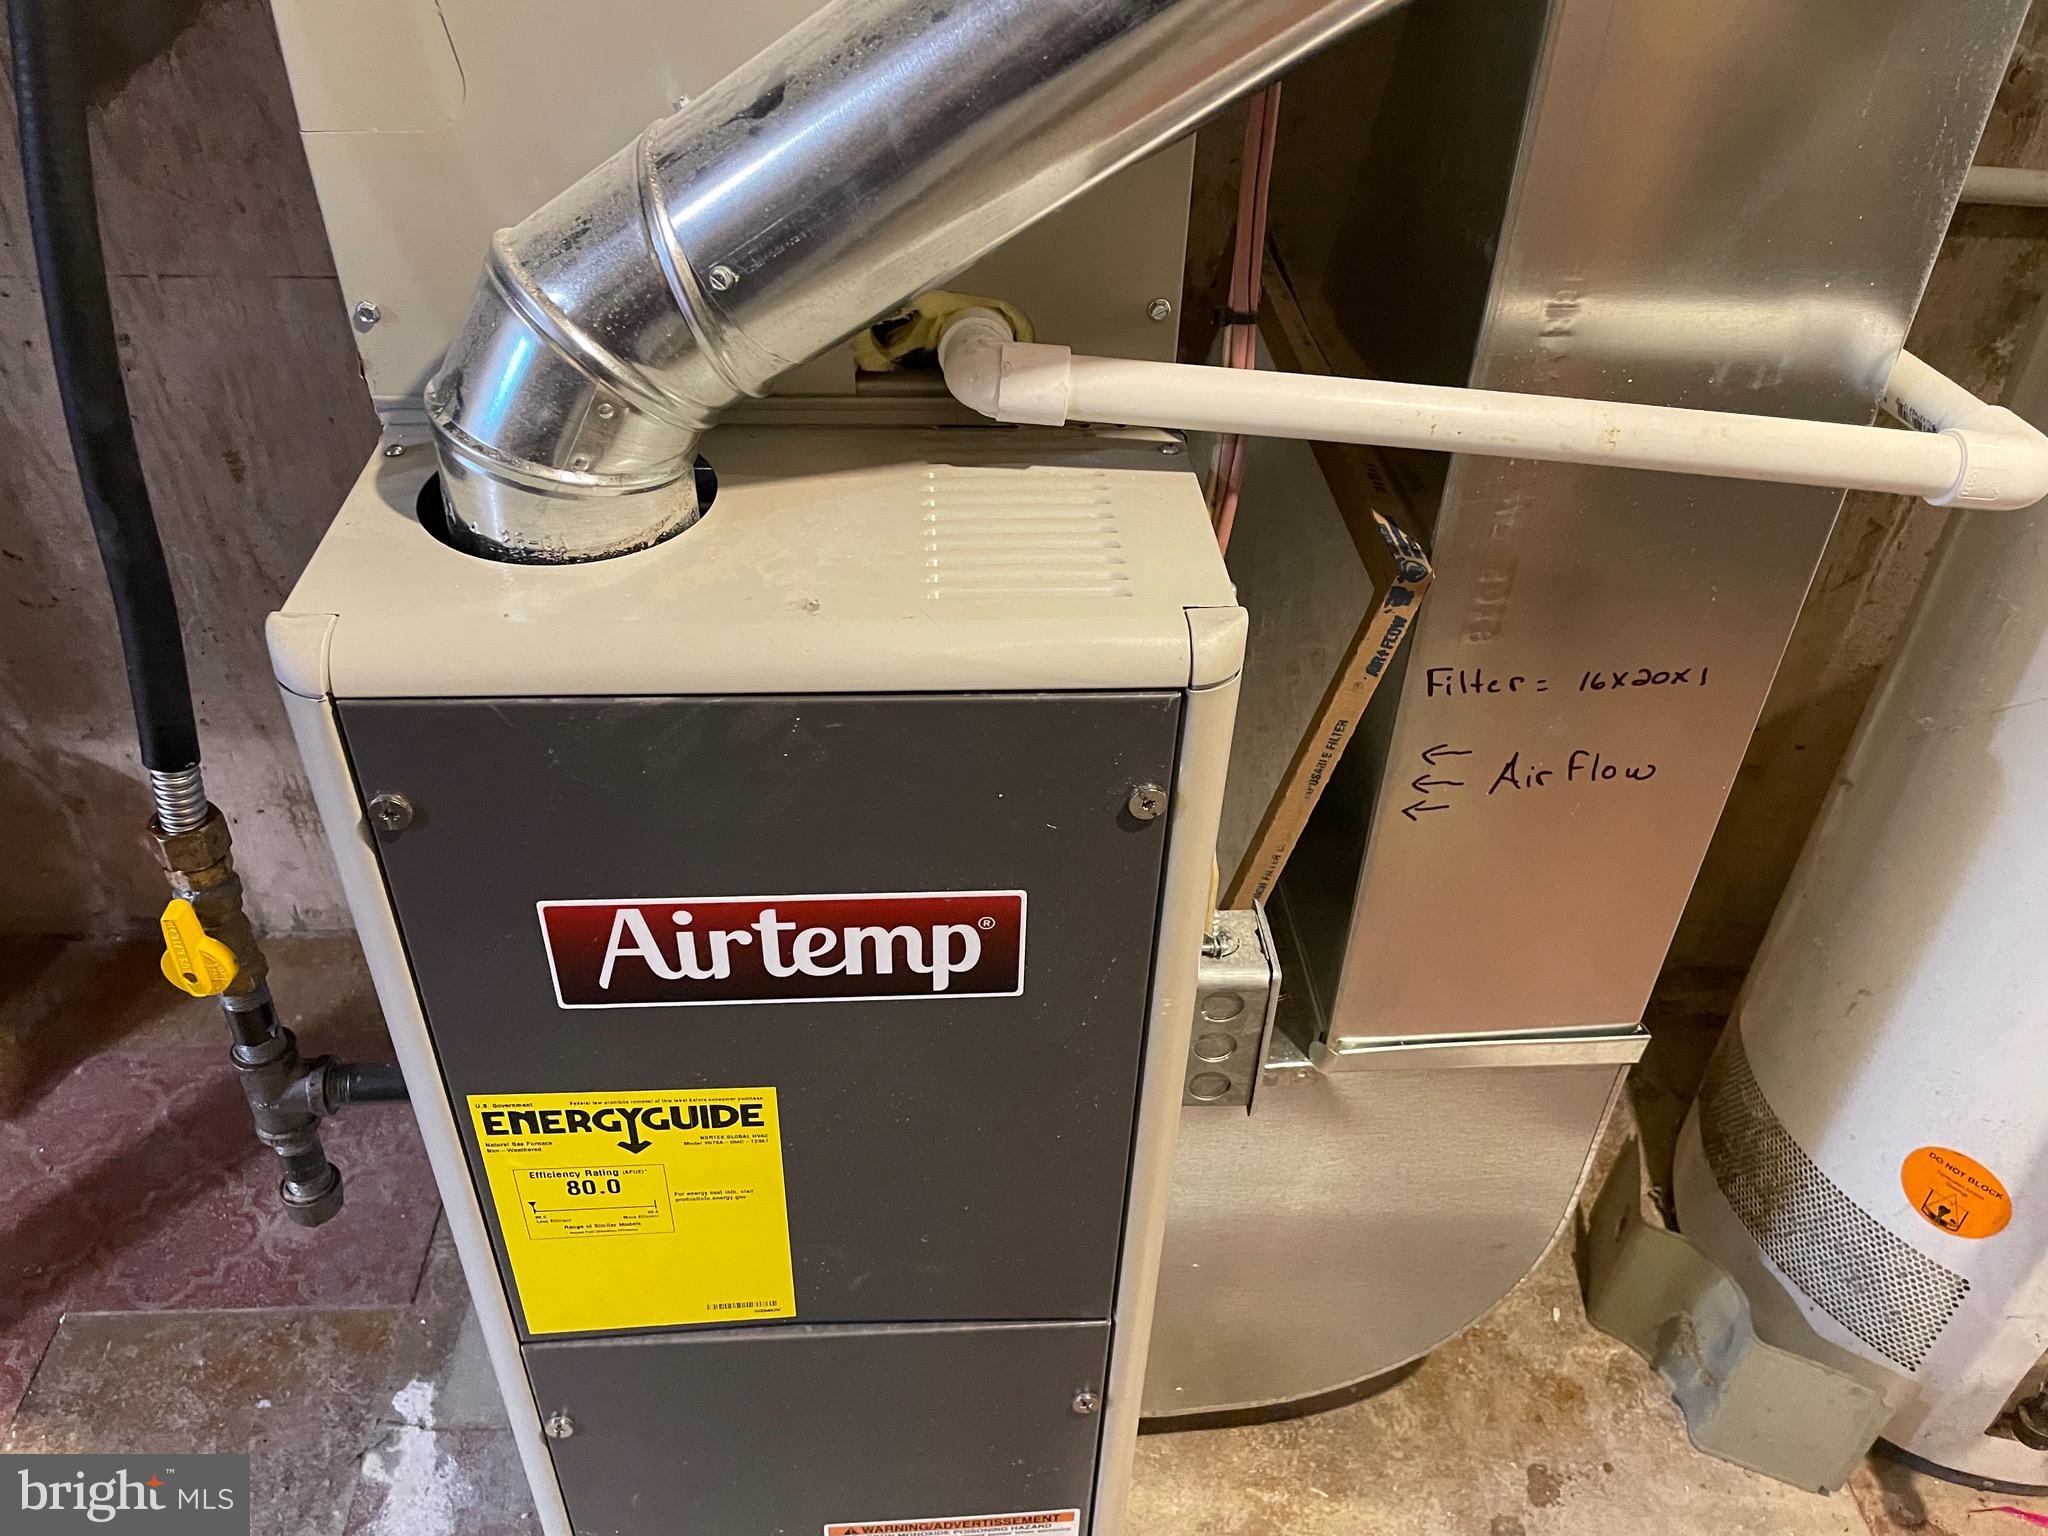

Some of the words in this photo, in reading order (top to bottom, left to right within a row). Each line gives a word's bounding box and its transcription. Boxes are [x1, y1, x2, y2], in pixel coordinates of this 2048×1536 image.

[1426, 668, 1525, 697] Filter
[1326, 718, 1348, 750] FILTER
[1488, 752, 1552, 794] Air
[1568, 750, 1656, 782] Flow
[481, 1104, 764, 1154] ENERGYGUIDE
[529, 1170, 581, 1179] Efficiency
[585, 1168, 619, 1177] Rating
[566, 1178, 622, 1196] 80.0
[1929, 1151, 1944, 1164] DO
[1945, 1163, 1967, 1178] NOT
[1967, 1176, 2004, 1200] BLOCK
